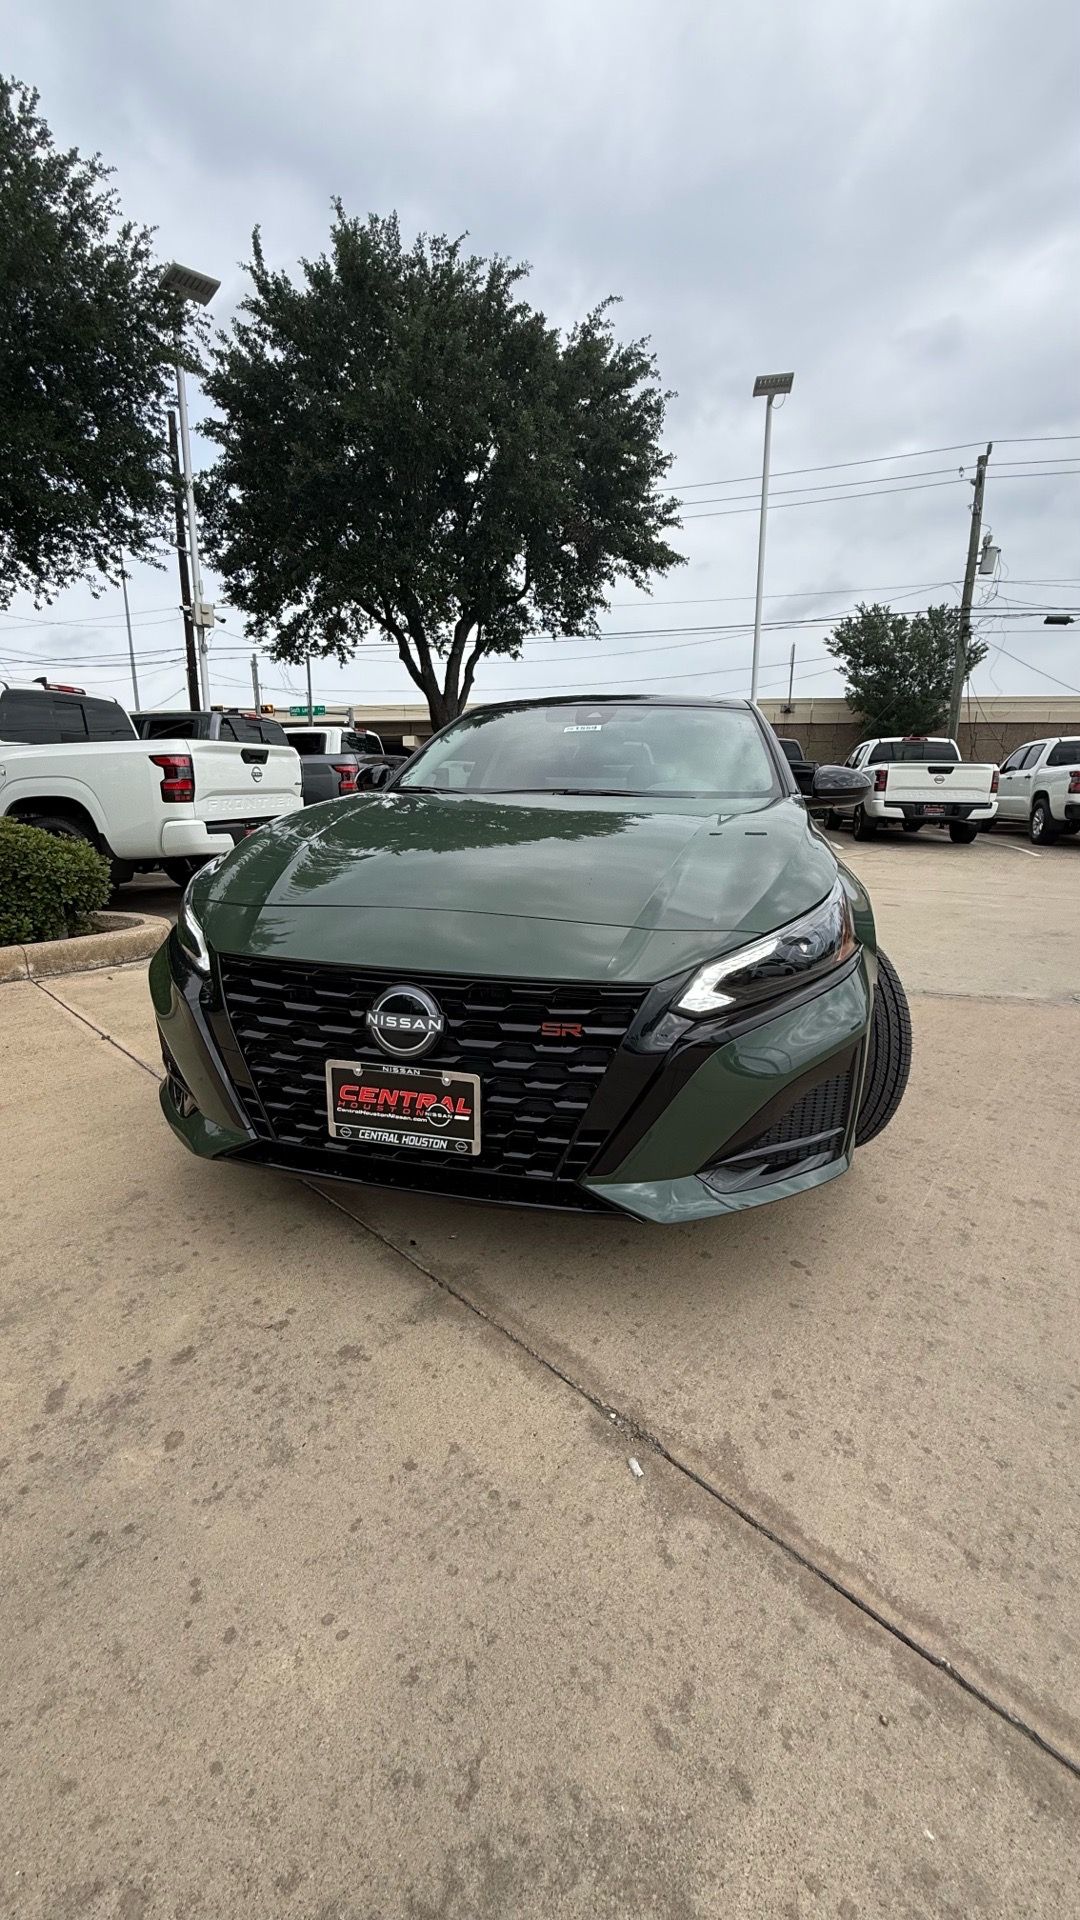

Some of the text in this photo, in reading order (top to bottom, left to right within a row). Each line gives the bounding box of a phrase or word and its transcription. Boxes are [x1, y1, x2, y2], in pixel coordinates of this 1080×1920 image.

[367, 1012, 442, 1030] NISSAN
[541, 1022, 582, 1037] SR
[382, 1066, 421, 1076] NISSAN
[339, 1084, 472, 1115] CENTRAL
[336, 1107, 428, 1122] CentralHoustonNissan.com
[337, 1100, 425, 1116] HOUSTON
[424, 1111, 453, 1119] NISSAN
[358, 1129, 399, 1144] CENTRAL
[401, 1135, 448, 1150] HOUSTON
